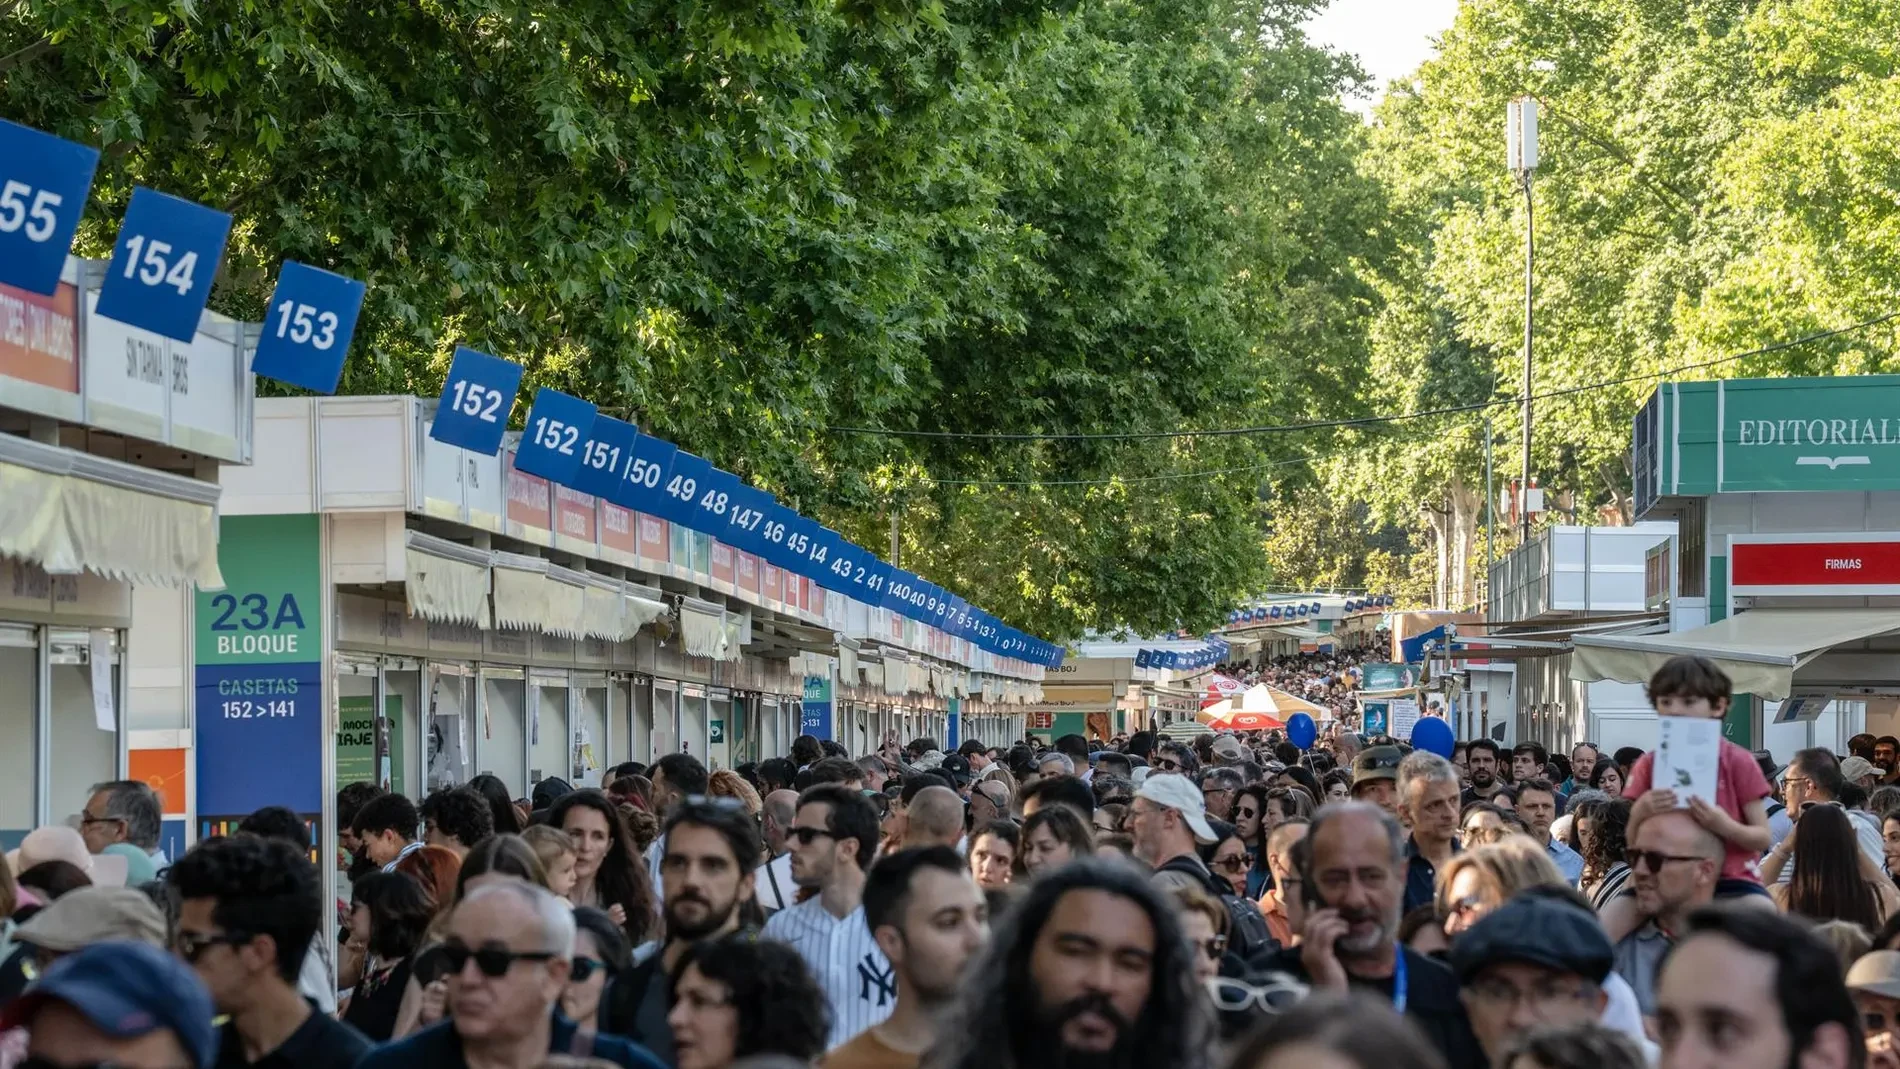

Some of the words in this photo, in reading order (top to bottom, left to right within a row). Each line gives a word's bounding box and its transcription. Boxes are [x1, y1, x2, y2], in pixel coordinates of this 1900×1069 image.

[123, 235, 198, 296] 154
[277, 300, 339, 350] 153
[453, 379, 502, 422] 152
[534, 417, 579, 456] 152
[1739, 418, 1900, 446] EDITORIAL
[583, 439, 620, 473] 151
[730, 505, 763, 531] 147
[1825, 558, 1862, 569] FIRMAS
[888, 581, 910, 600] 140
[211, 593, 306, 631] 23A
[217, 634, 298, 655] BLOQUE
[219, 678, 298, 696] CASETAS
[222, 701, 253, 719] 152
